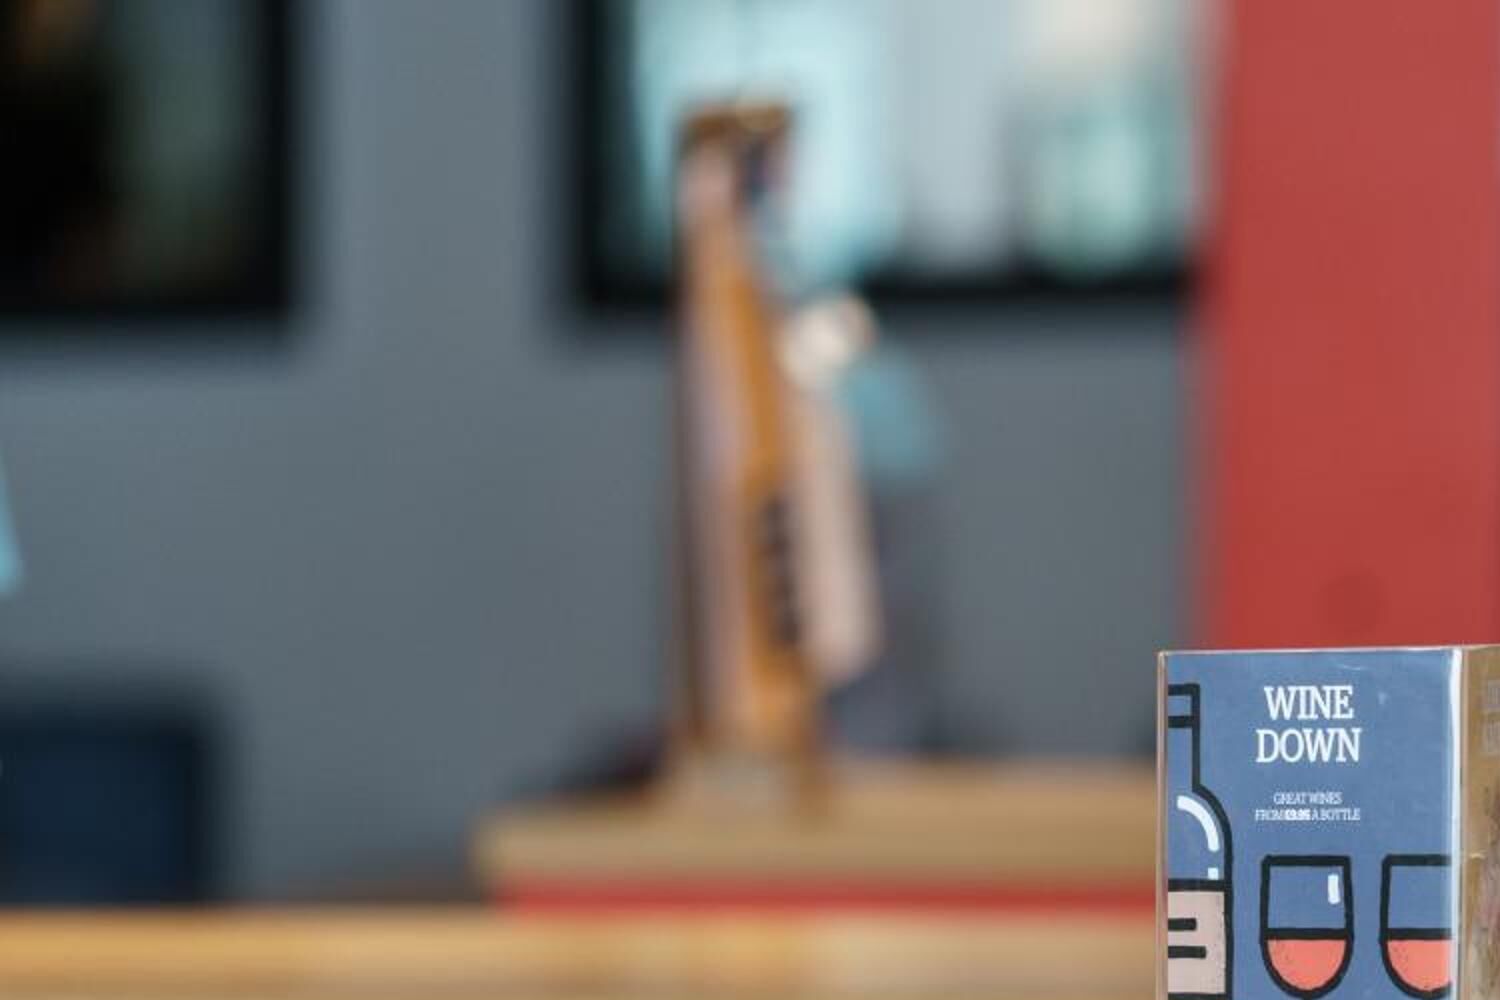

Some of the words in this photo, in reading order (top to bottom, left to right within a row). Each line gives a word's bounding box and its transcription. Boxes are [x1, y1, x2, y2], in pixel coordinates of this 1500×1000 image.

[1263, 684, 1354, 721] WINE
[1254, 726, 1363, 763] DOWN
[1273, 791, 1308, 805] GREAT
[1309, 791, 1343, 805] WINES
[1255, 808, 1284, 821] FROM
[1311, 808, 1320, 821] A
[1321, 808, 1361, 821] BOTTLE
